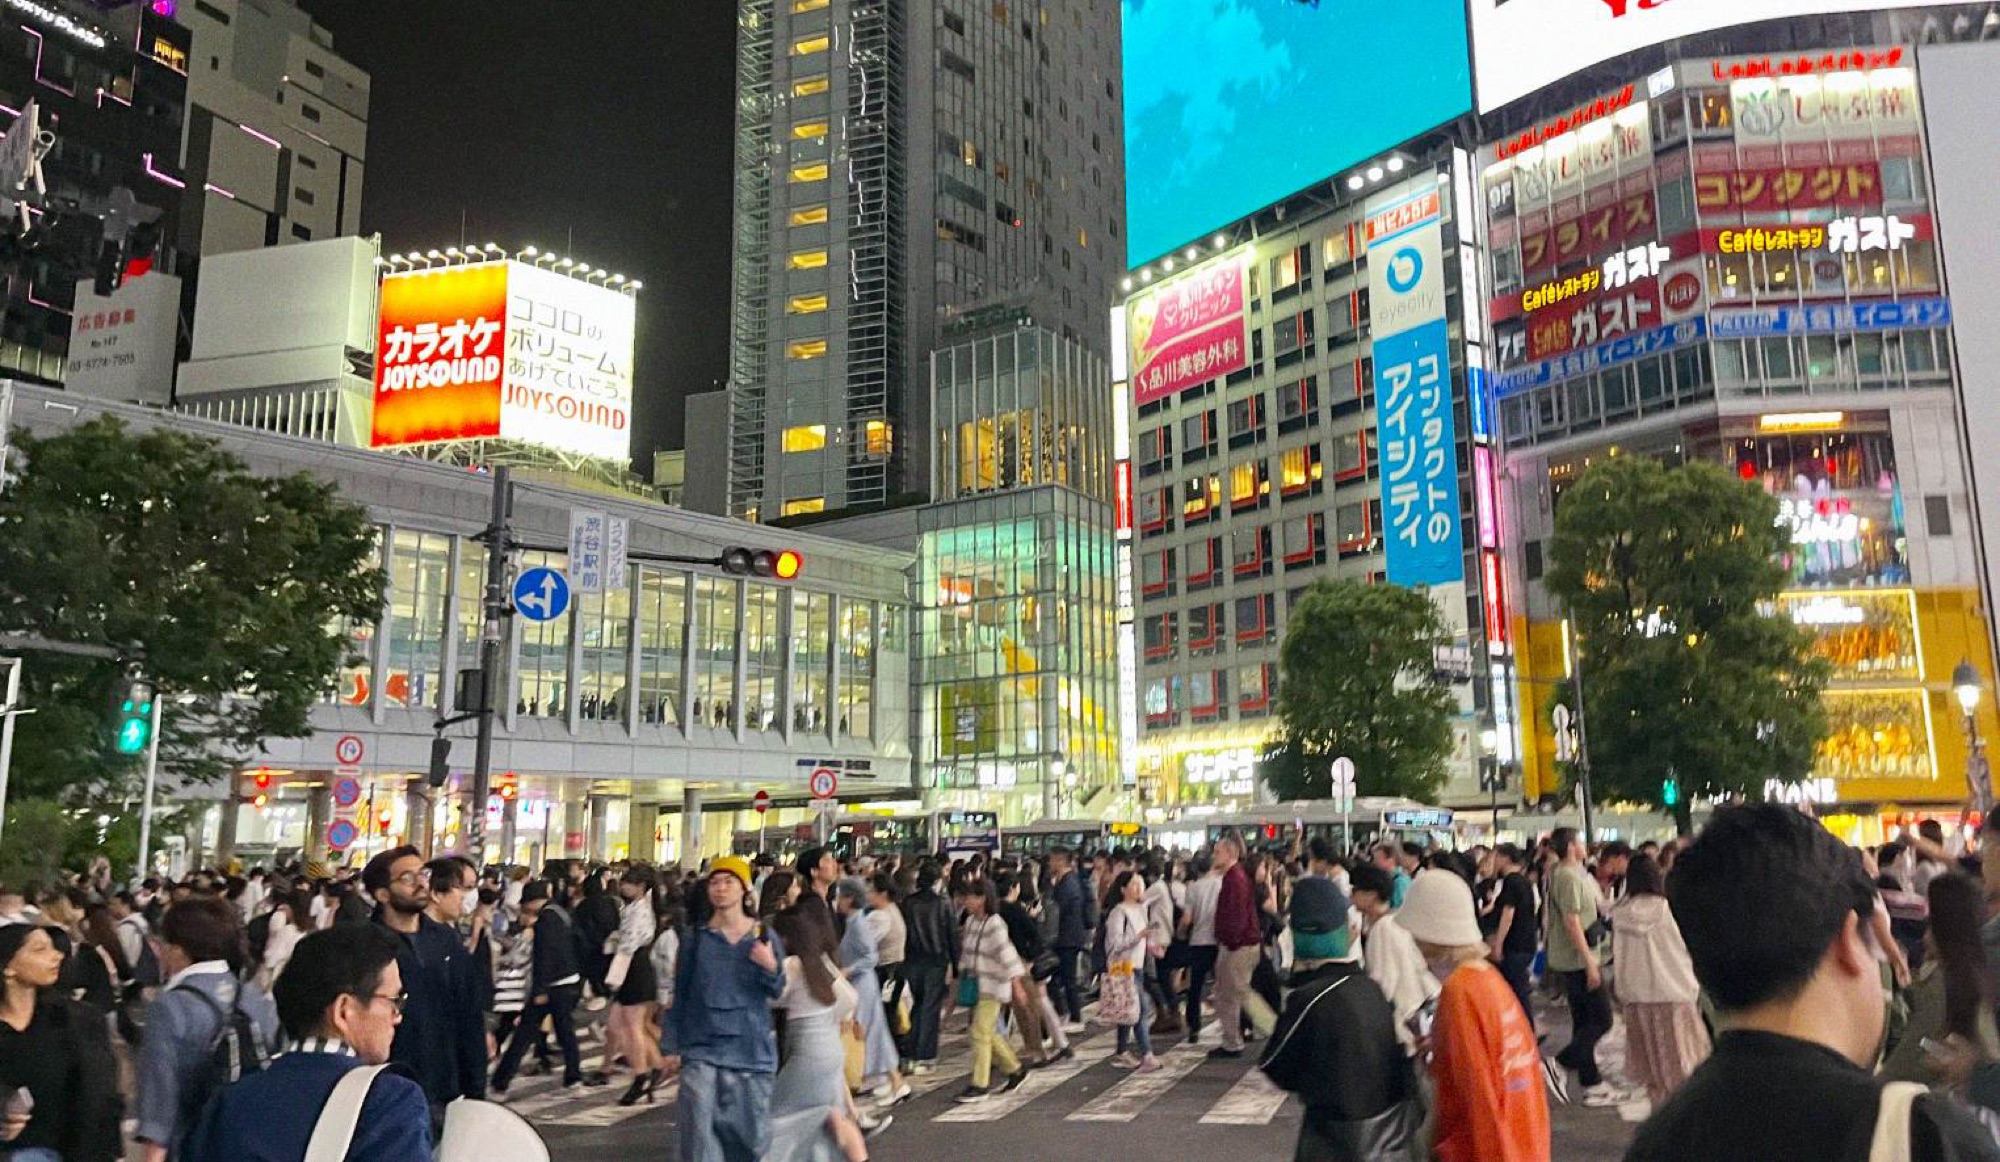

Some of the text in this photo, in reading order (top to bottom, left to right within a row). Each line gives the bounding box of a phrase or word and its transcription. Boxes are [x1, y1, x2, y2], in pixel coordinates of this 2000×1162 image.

[1697, 167, 1874, 204] コンタクト
[1828, 215, 1915, 254] ガスト
[1603, 241, 1670, 291] ガスト
[383, 317, 501, 364] カラオケ
[512, 295, 603, 341] ココロの
[1572, 292, 1652, 348] ガスト
[1149, 335, 1239, 391] 品川美容外科
[1500, 330, 1526, 364] 7F
[380, 356, 501, 392] JOYSOUND
[504, 383, 626, 430] JOYSOUND
[1382, 362, 1422, 548] アイシティ
[1418, 354, 1451, 544] コンタクトの
[584, 517, 601, 588] 渋谷駅前
